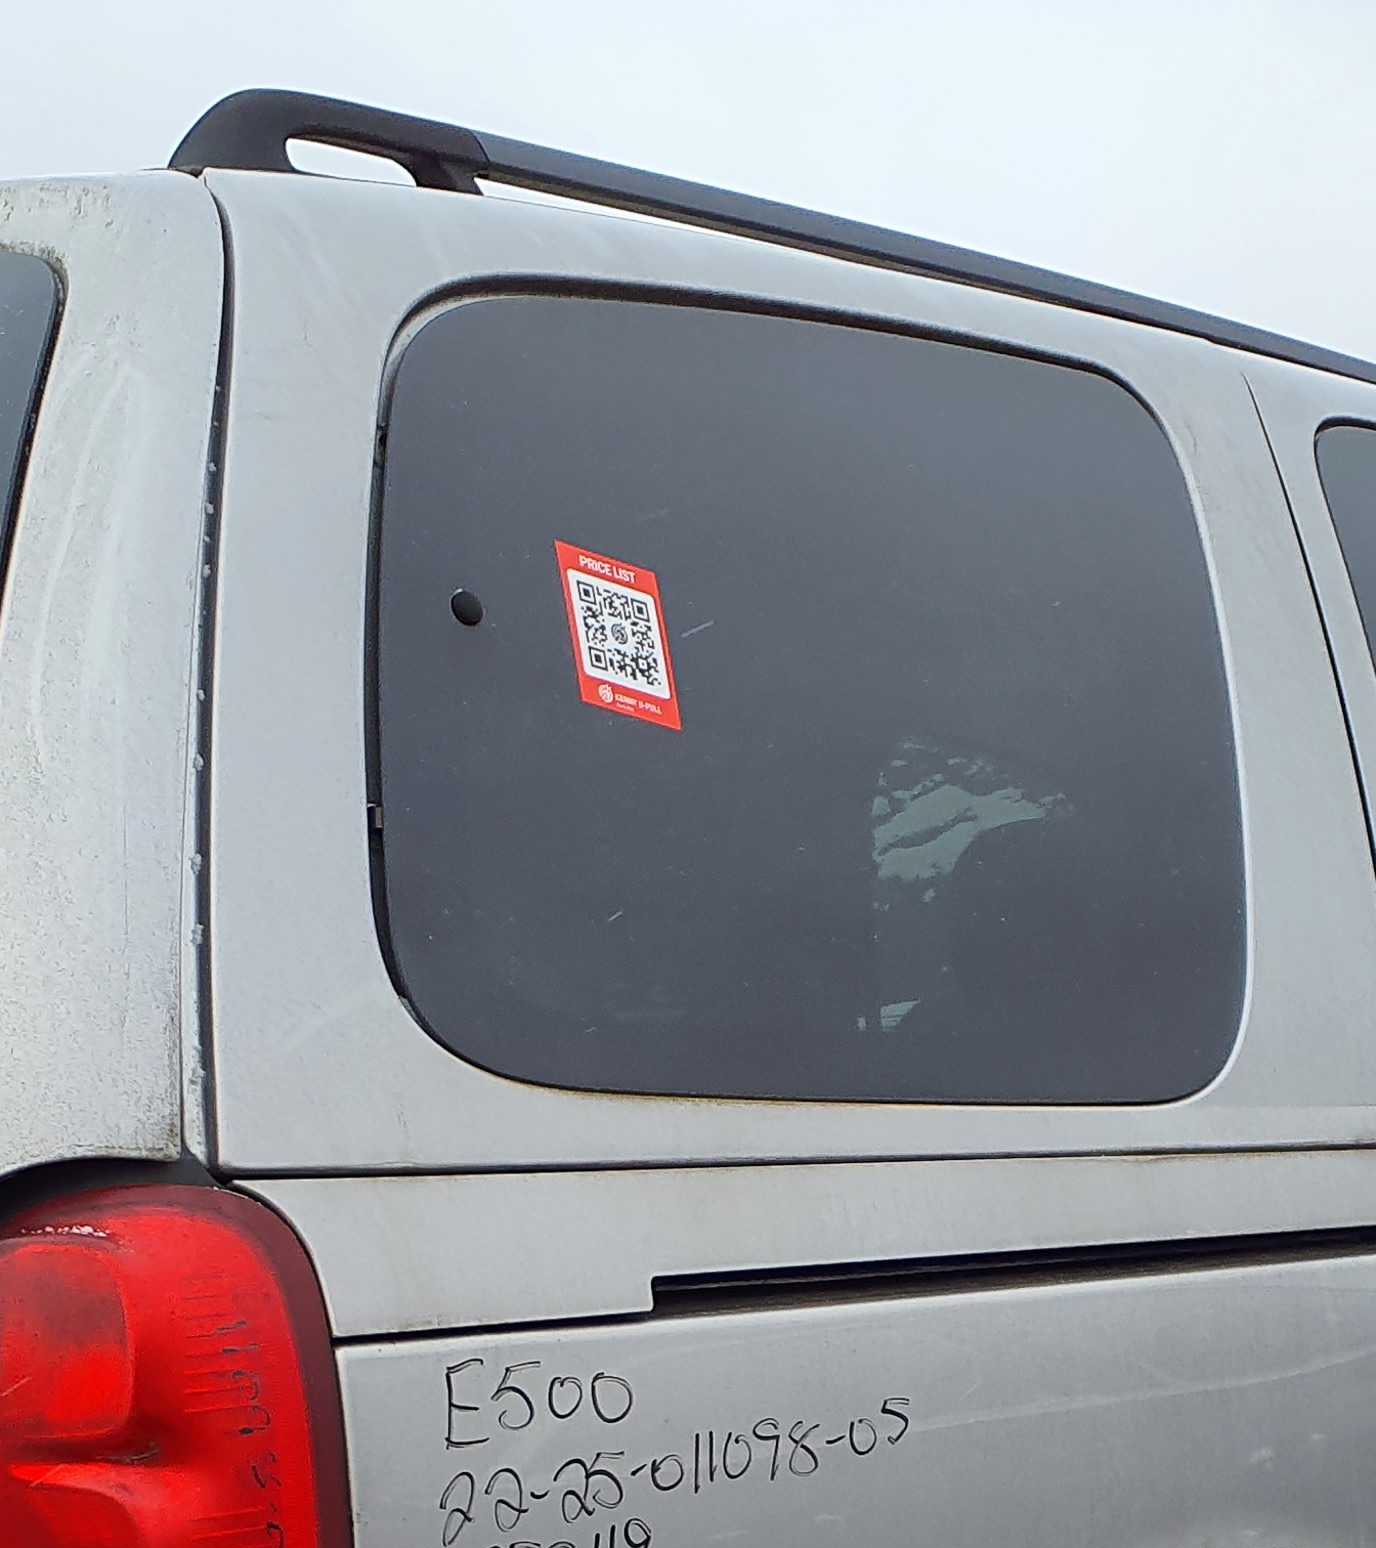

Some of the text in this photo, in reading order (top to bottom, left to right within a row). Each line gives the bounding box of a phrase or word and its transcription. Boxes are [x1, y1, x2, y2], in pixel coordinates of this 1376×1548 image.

[579, 554, 636, 584] PRICE LIST
[444, 1358, 634, 1451] E500
[439, 1397, 910, 1548] 22-25-011098-05
